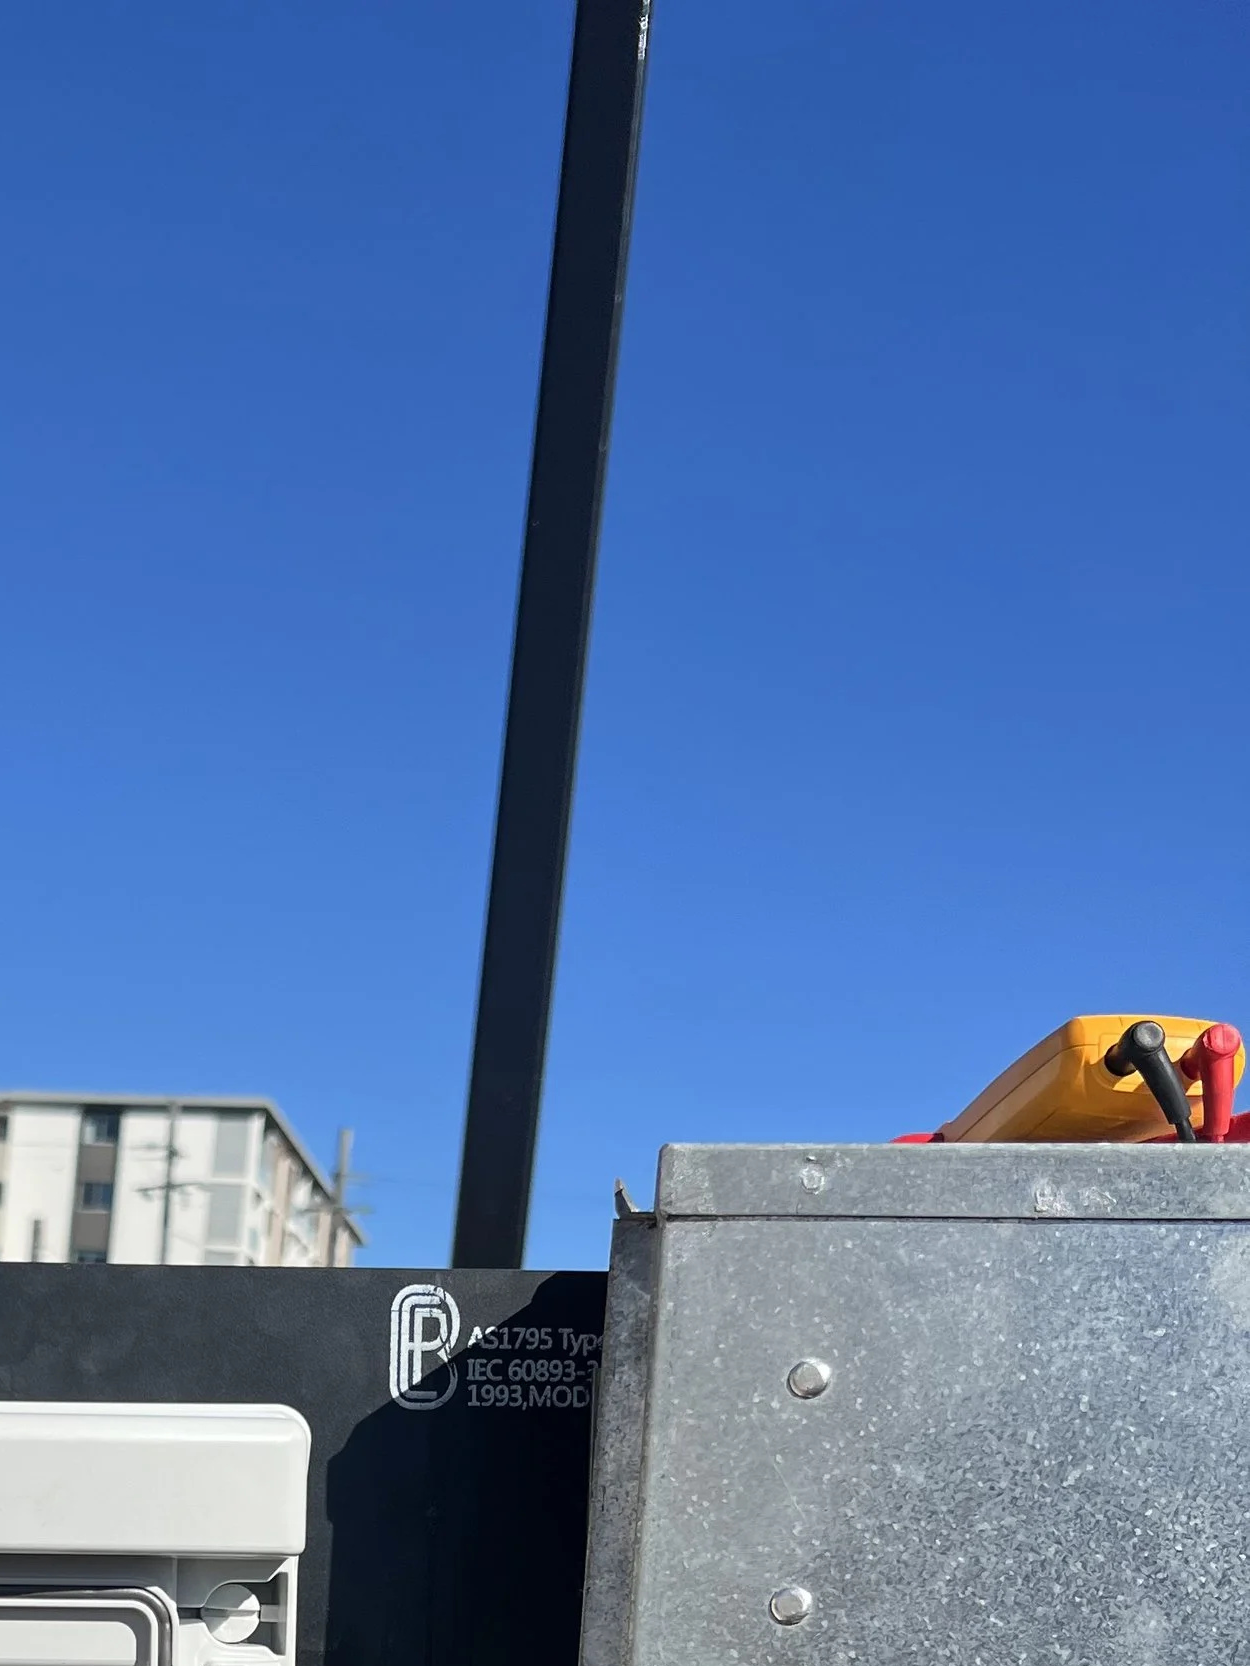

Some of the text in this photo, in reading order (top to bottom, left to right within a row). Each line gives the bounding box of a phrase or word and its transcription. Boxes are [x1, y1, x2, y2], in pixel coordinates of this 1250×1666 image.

[467, 1326, 553, 1350] AS1795
[466, 1359, 503, 1381] IEC
[467, 1384, 590, 1410] 1993,MOD
